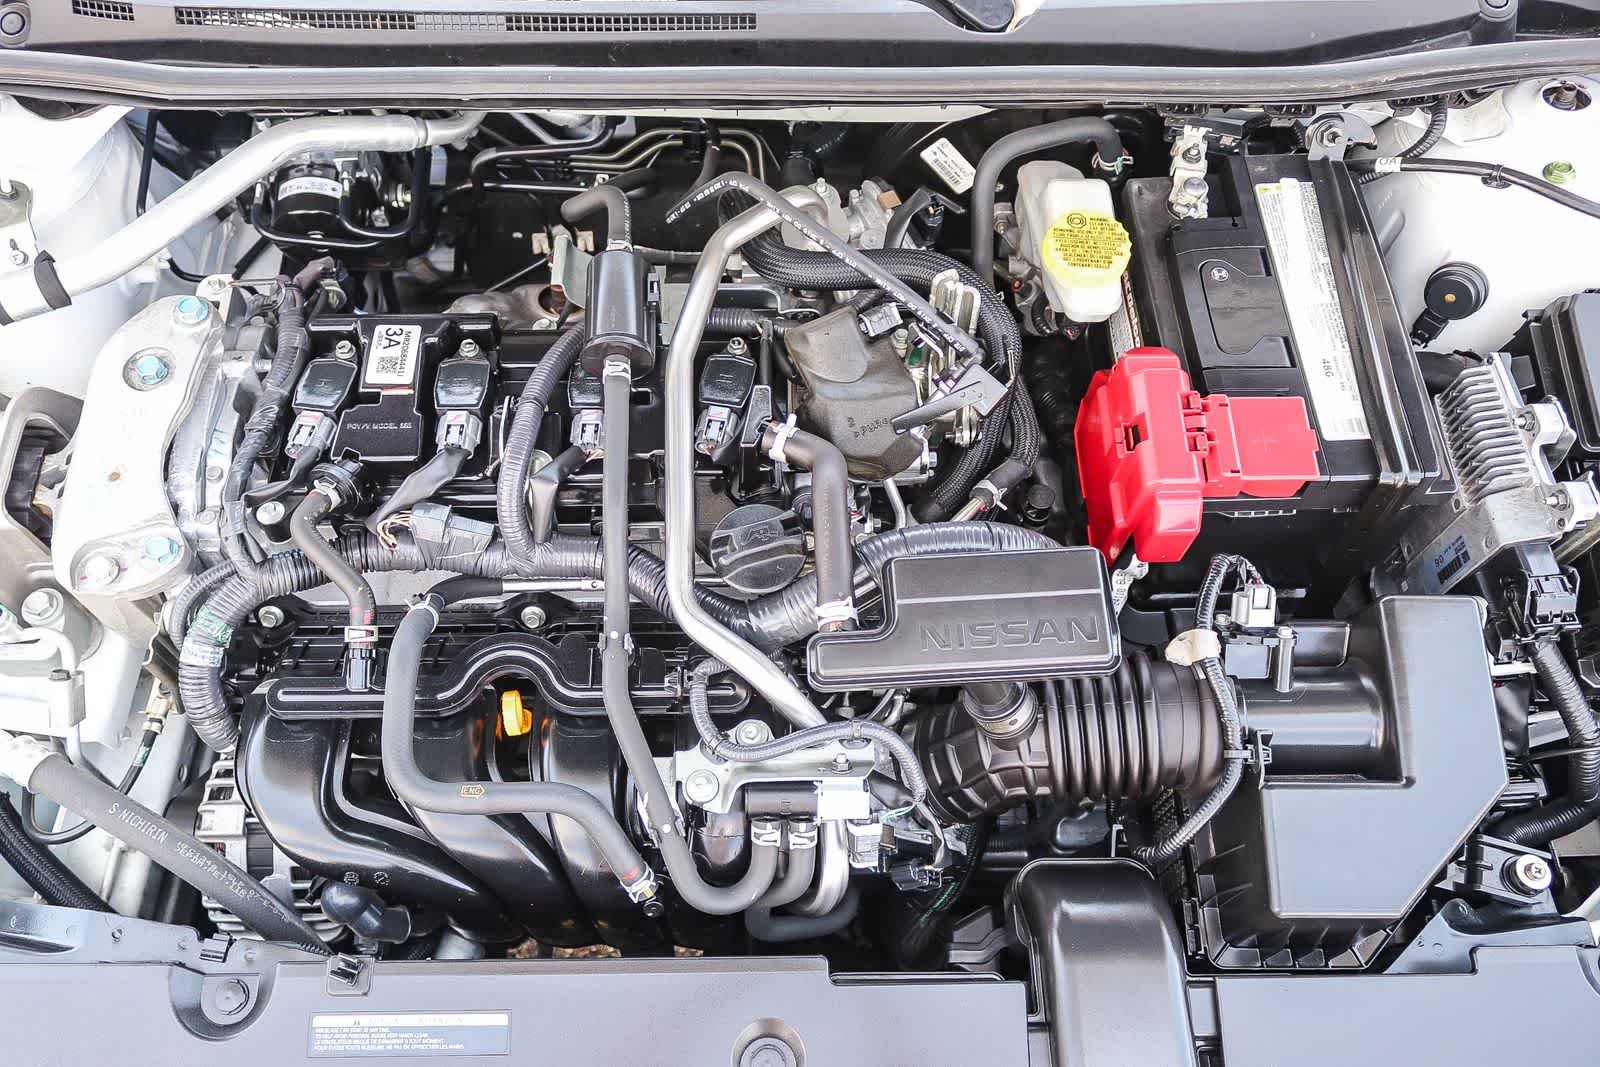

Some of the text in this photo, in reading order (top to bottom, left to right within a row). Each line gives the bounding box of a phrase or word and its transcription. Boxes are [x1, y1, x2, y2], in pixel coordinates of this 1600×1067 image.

[383, 327, 403, 349] 3A
[920, 615, 1101, 652] NISSAN
[120, 808, 169, 844] NICHIRIN
